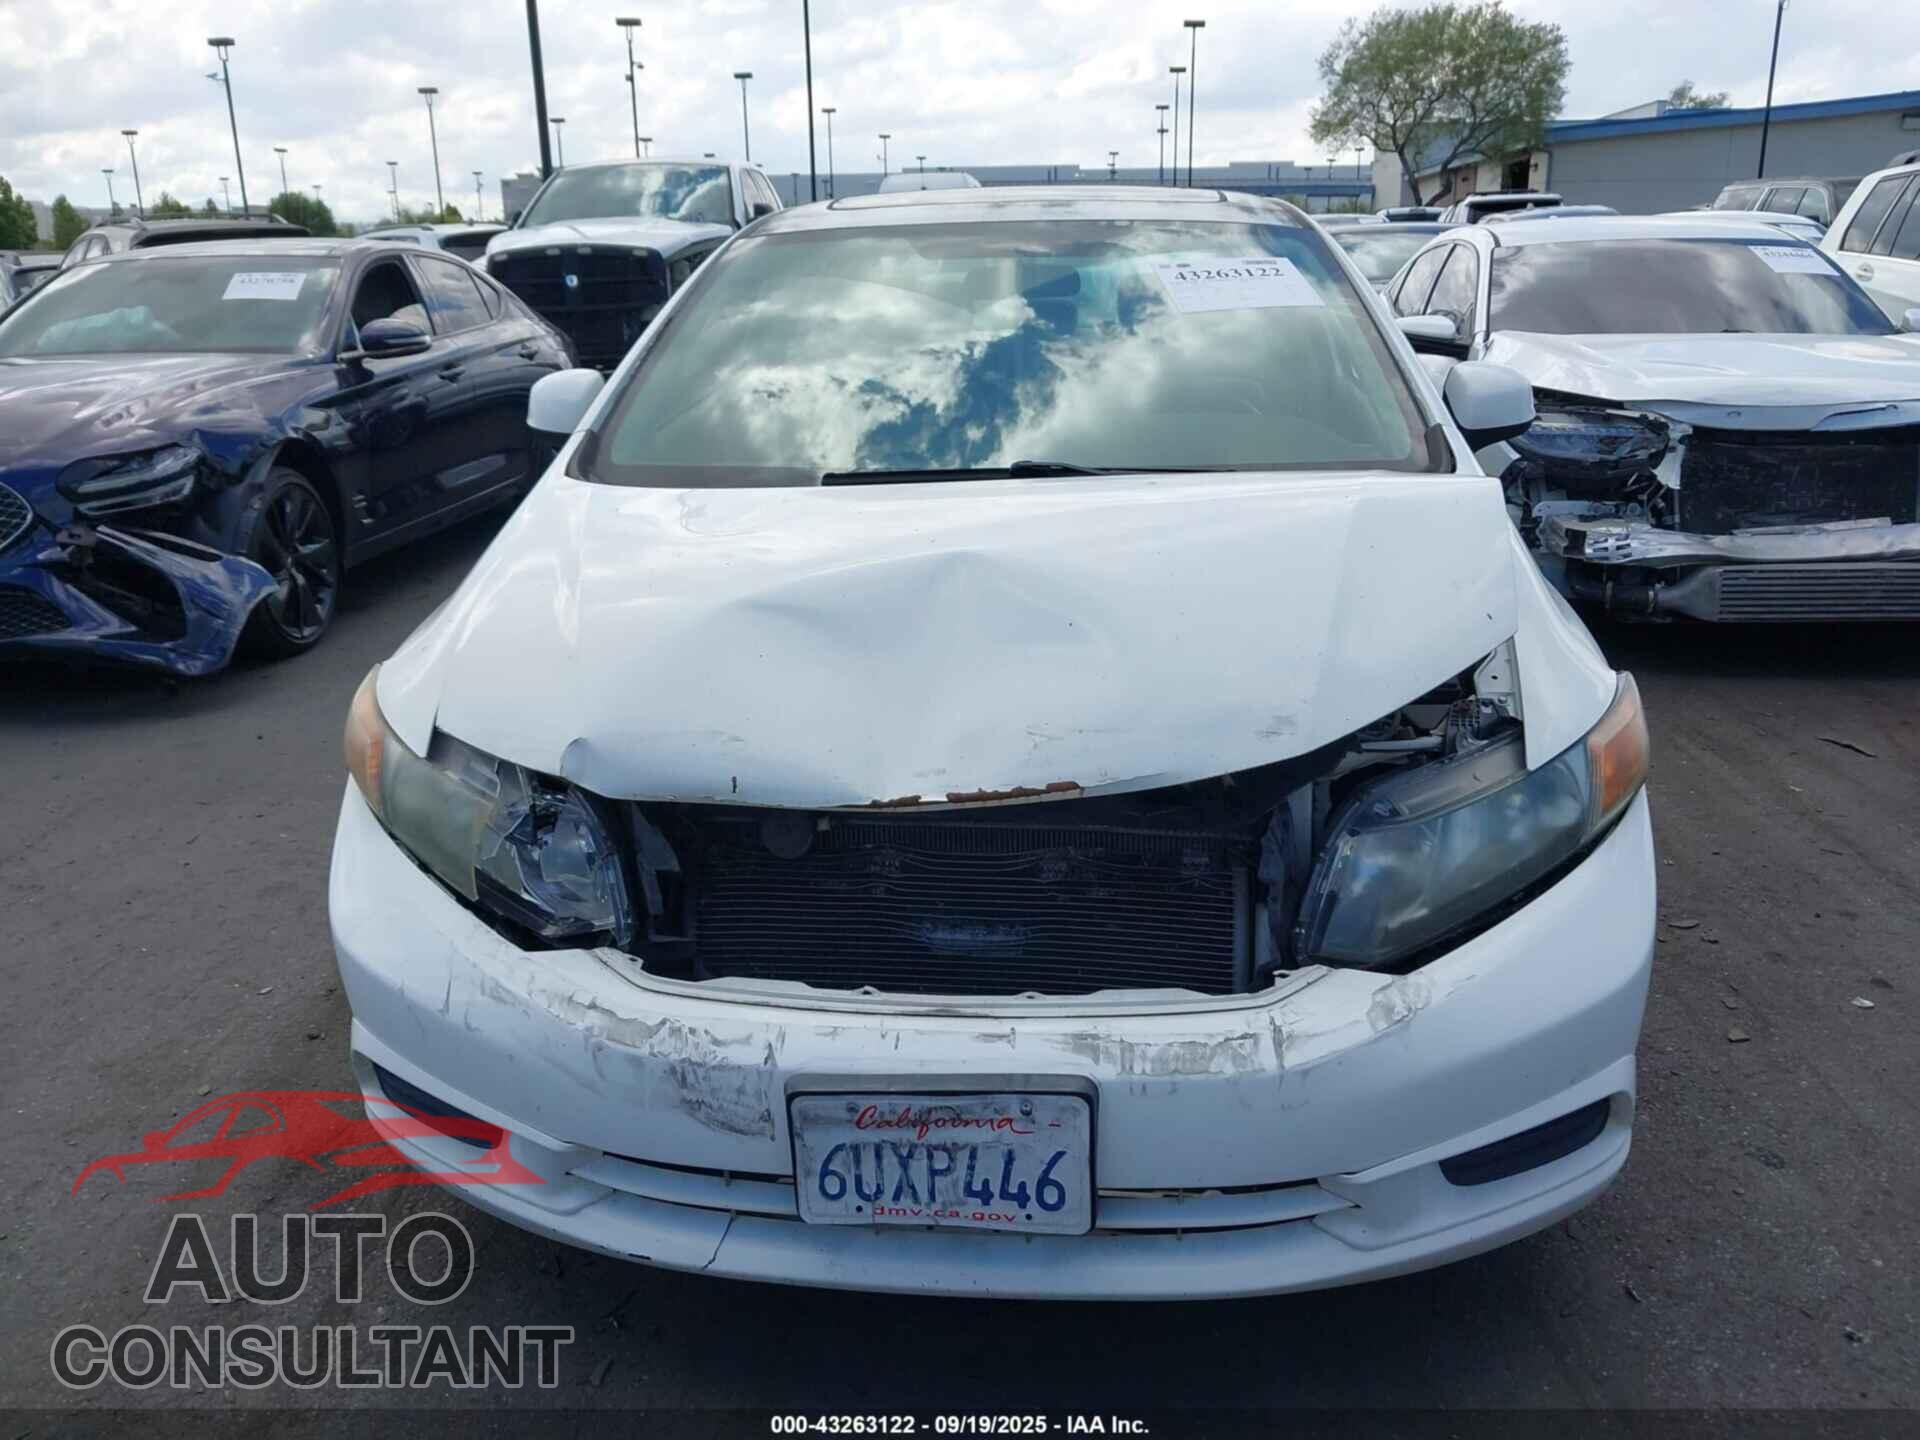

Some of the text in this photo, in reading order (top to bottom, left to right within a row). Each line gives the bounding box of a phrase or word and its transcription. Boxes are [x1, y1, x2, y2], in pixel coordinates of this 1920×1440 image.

[1175, 267, 1284, 281] 43263122
[855, 1104, 1034, 1141] California
[817, 1143, 1068, 1212] 6UXP446
[872, 1204, 1017, 1223] dmv.ca.gov
